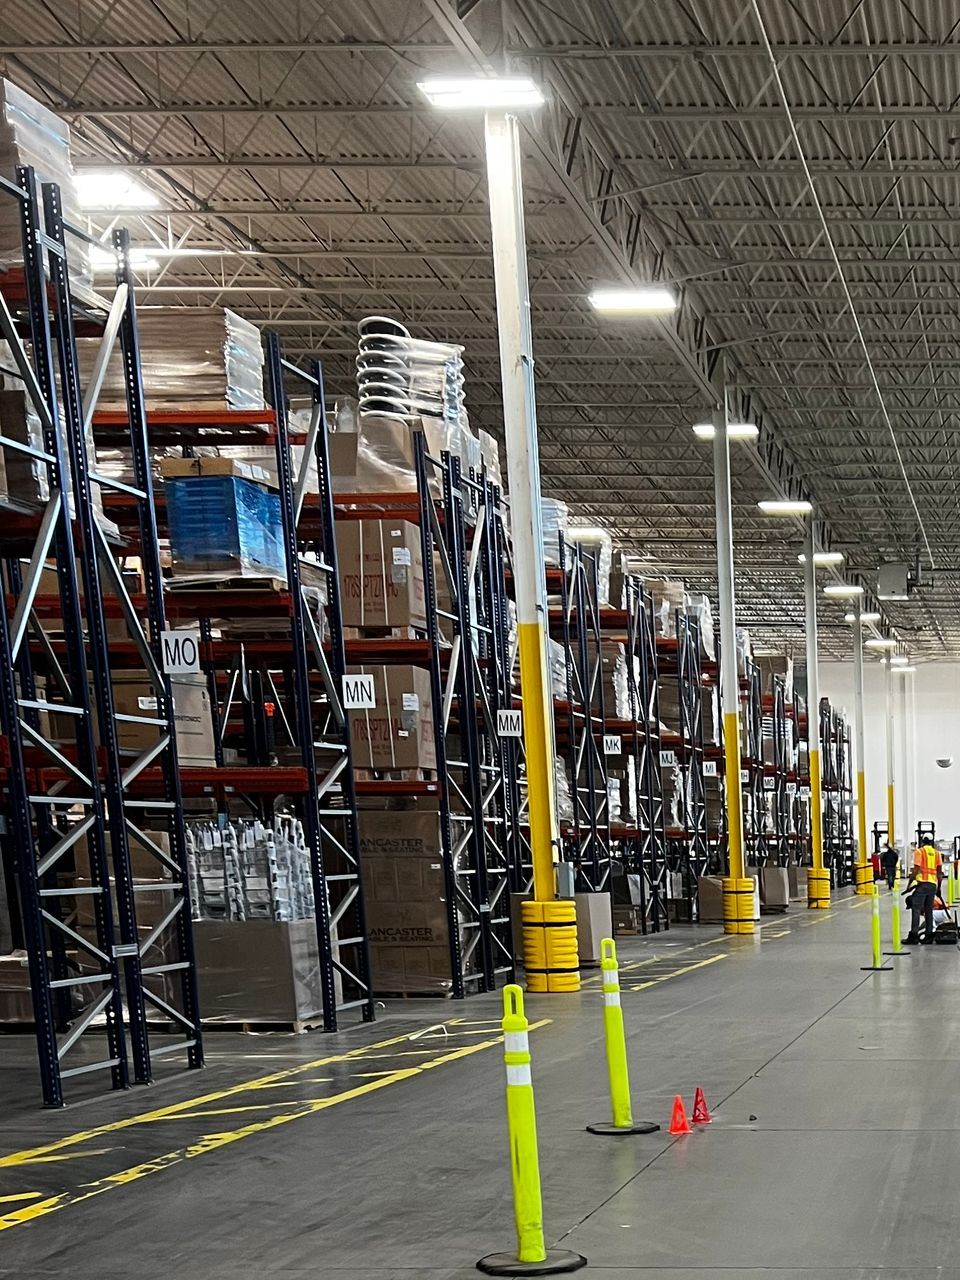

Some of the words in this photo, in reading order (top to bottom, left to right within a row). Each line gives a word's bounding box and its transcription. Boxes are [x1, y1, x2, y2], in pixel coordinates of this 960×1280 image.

[164, 637, 197, 666] MO
[345, 680, 373, 703] MN
[498, 714, 520, 732] MM
[605, 739, 619, 750] MK
[661, 753, 673, 764] MJ
[764, 778, 774, 787] MG
[361, 838, 424, 847] ANCASTER
[369, 927, 433, 936] ANCASTER
